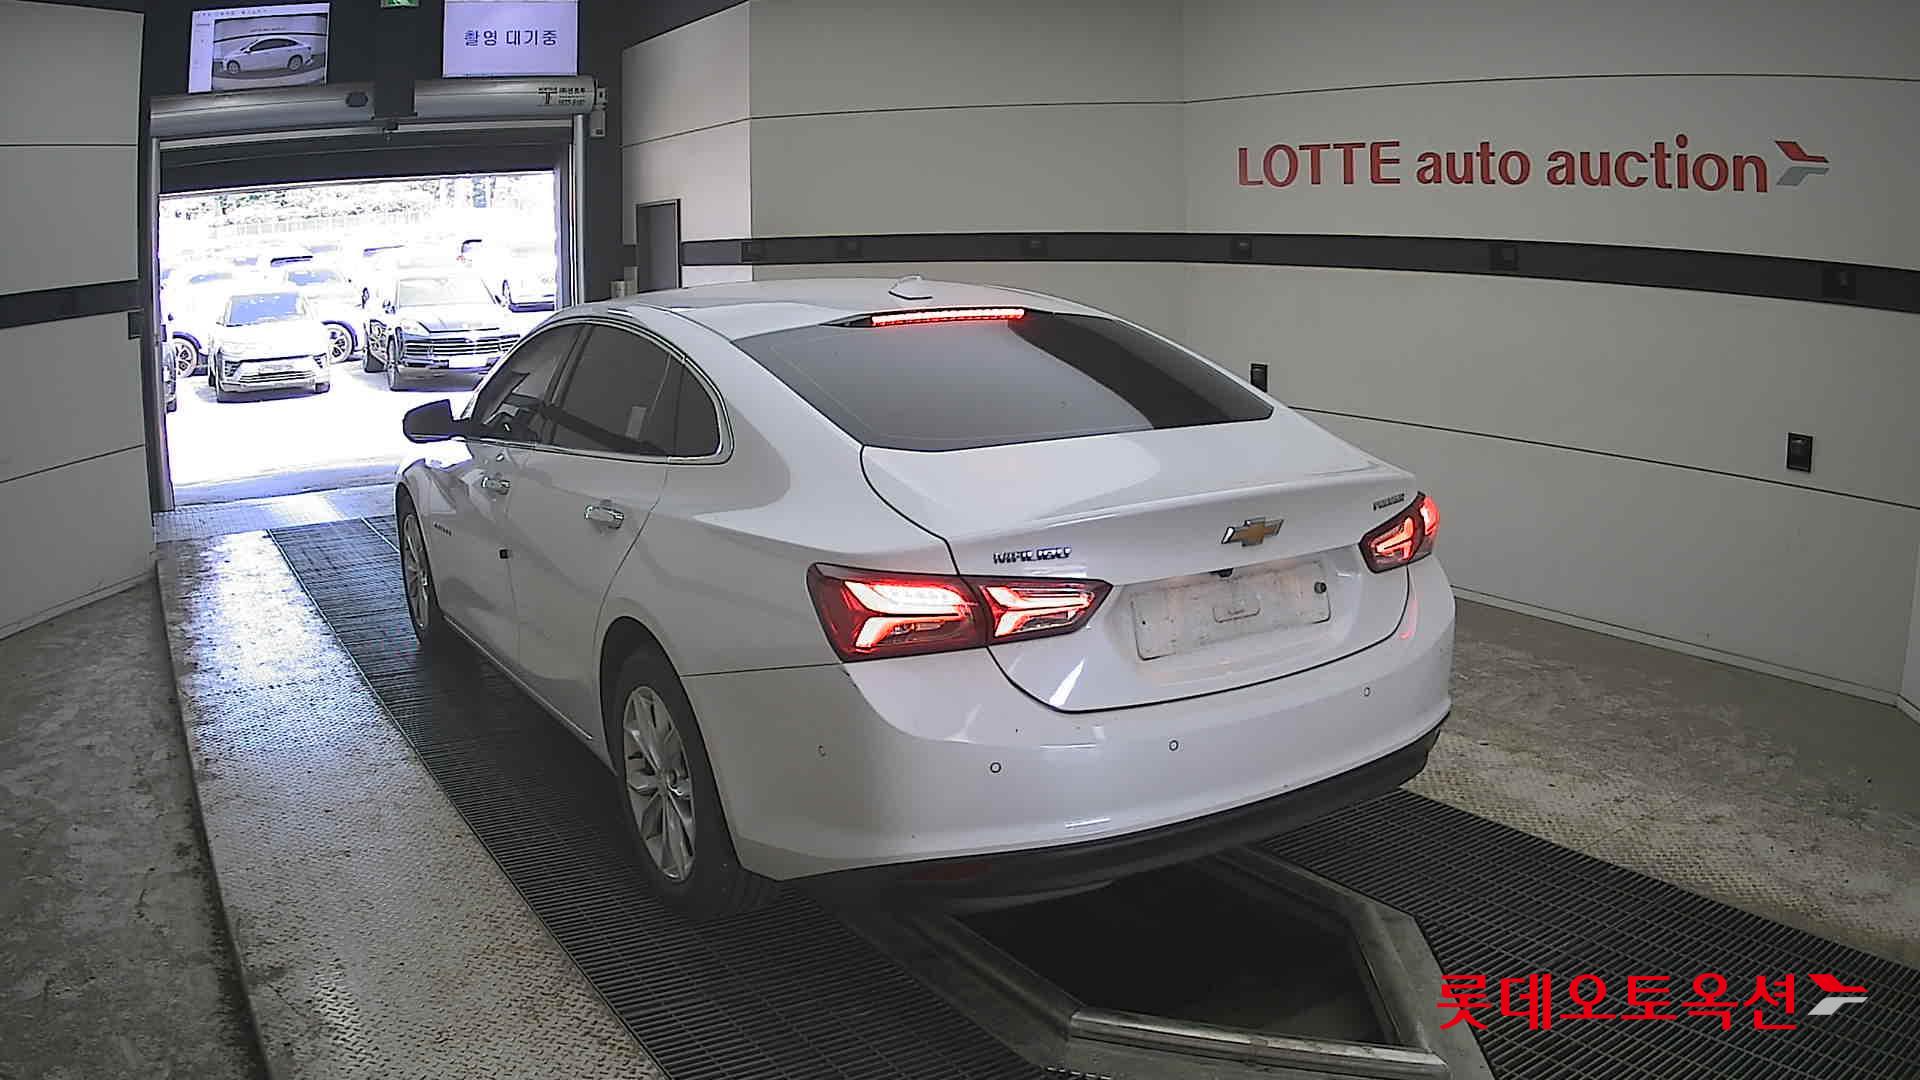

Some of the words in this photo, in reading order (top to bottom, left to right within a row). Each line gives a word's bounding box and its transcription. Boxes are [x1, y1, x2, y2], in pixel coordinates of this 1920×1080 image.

[464, 30, 498, 46] 촬영
[506, 30, 557, 46] 대기중
[1237, 140, 1400, 189] LOTTE
[1417, 143, 1532, 186] auto
[1547, 135, 1769, 193] auction
